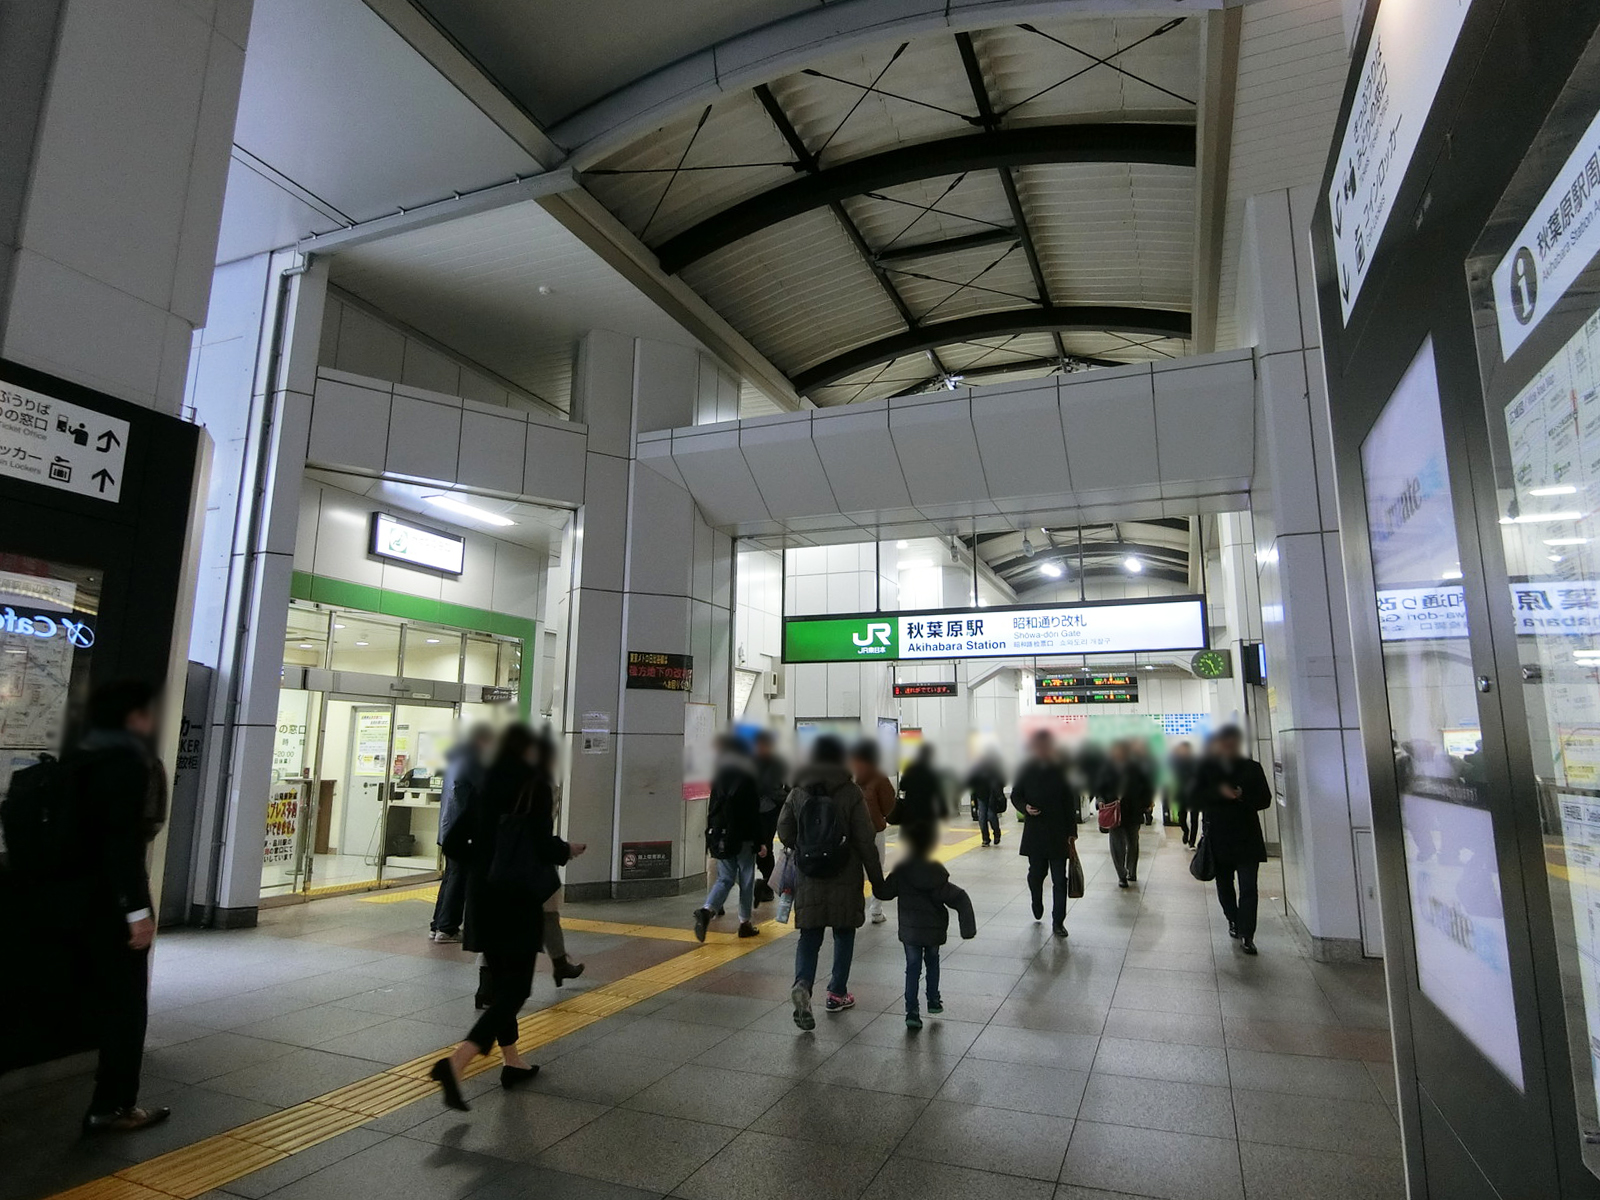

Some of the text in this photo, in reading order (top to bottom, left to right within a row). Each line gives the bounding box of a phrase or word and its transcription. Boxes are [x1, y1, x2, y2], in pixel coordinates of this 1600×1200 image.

[1365, 113, 1402, 229] コインロッカー
[1536, 145, 1600, 261] 秋葉原駅周
[1569, 209, 1594, 245] Station
[907, 619, 984, 640] 秋葉原駅
[1013, 614, 1088, 630] 昭和通り改札
[852, 622, 892, 647] JR
[1060, 629, 1081, 637] Gate
[908, 639, 1007, 652] Akihabara Station
[279, 724, 306, 734] の窓口
